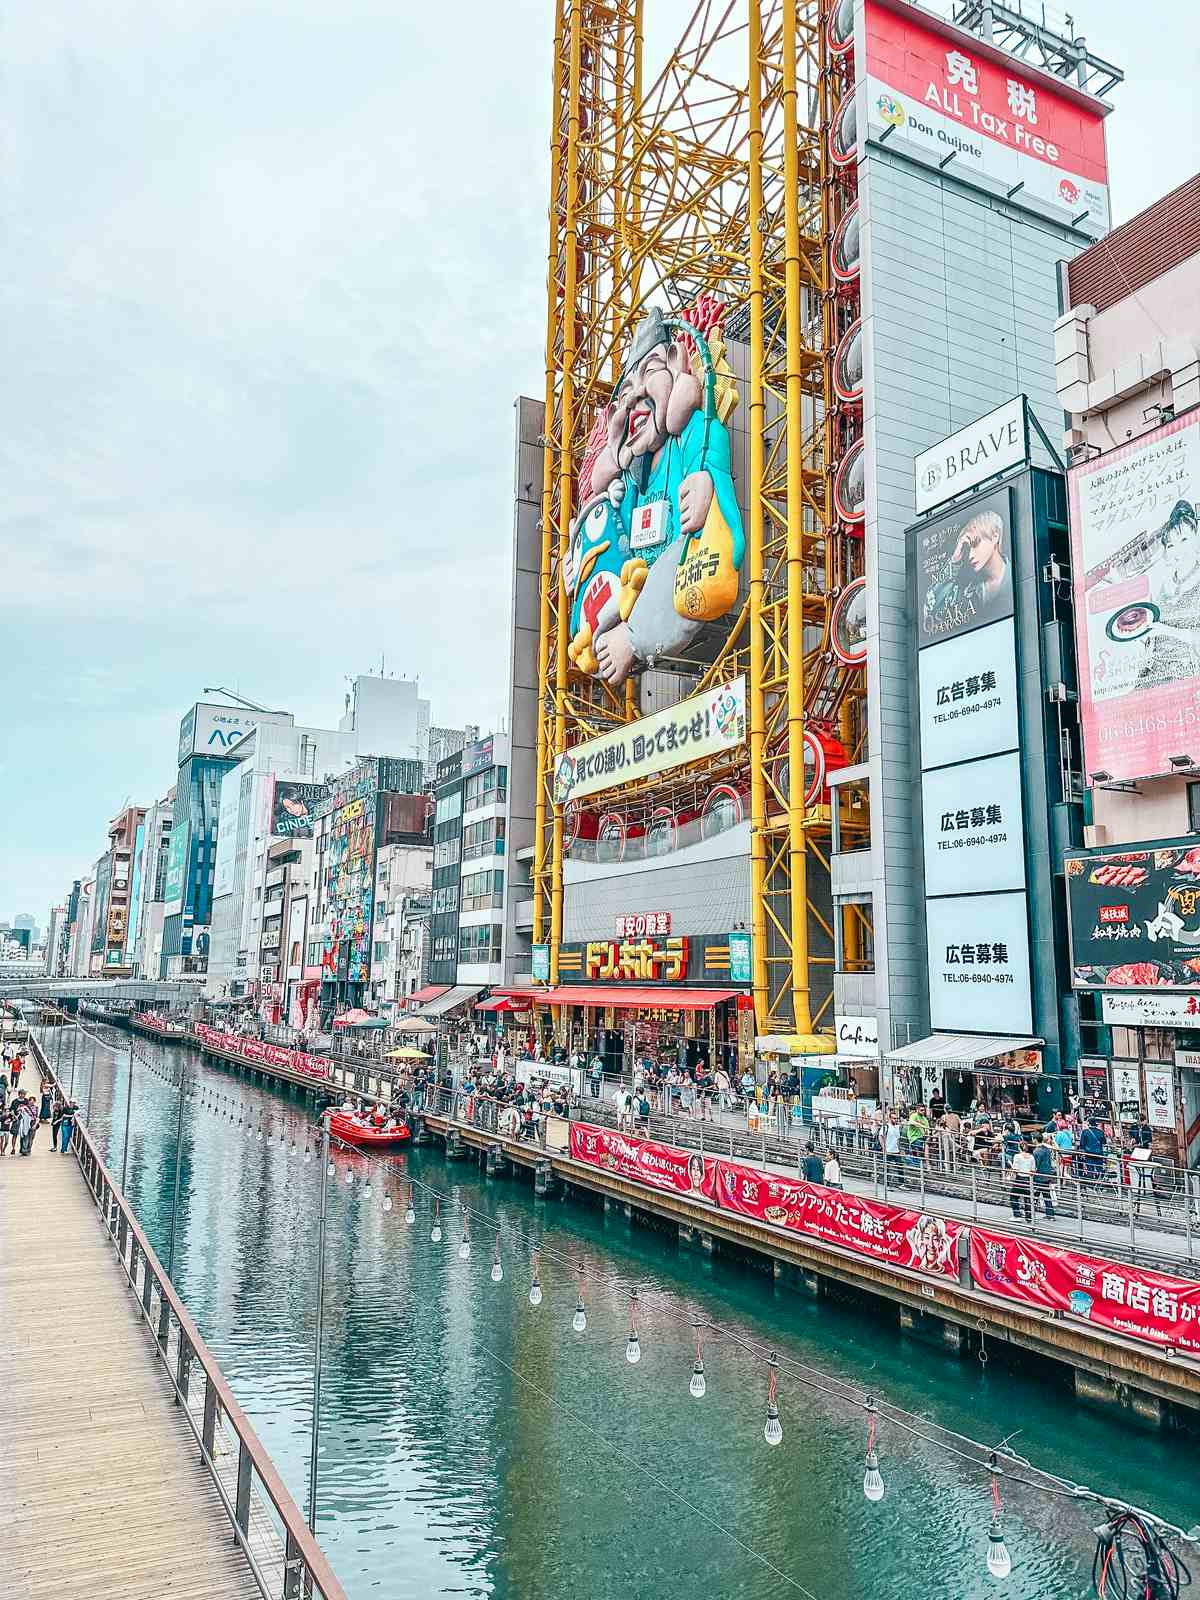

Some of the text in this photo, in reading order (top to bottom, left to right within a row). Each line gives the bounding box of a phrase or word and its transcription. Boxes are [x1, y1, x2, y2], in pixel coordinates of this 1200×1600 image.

[945, 50, 1038, 124] 免税
[924, 82, 1060, 162] ALL Tax Free
[908, 116, 982, 159] Don Quijote
[945, 420, 1018, 479] BRAVE
[937, 671, 996, 706] 広告募集
[933, 697, 1001, 724] TEL:06-6940-4974
[941, 804, 1002, 831] 広告募集
[937, 833, 1007, 850] TEL:06-6940-4974
[946, 943, 1008, 964] 広告募集
[943, 973, 1014, 984] TEL:06-6940-4974
[840, 1024, 863, 1044] Cafe
